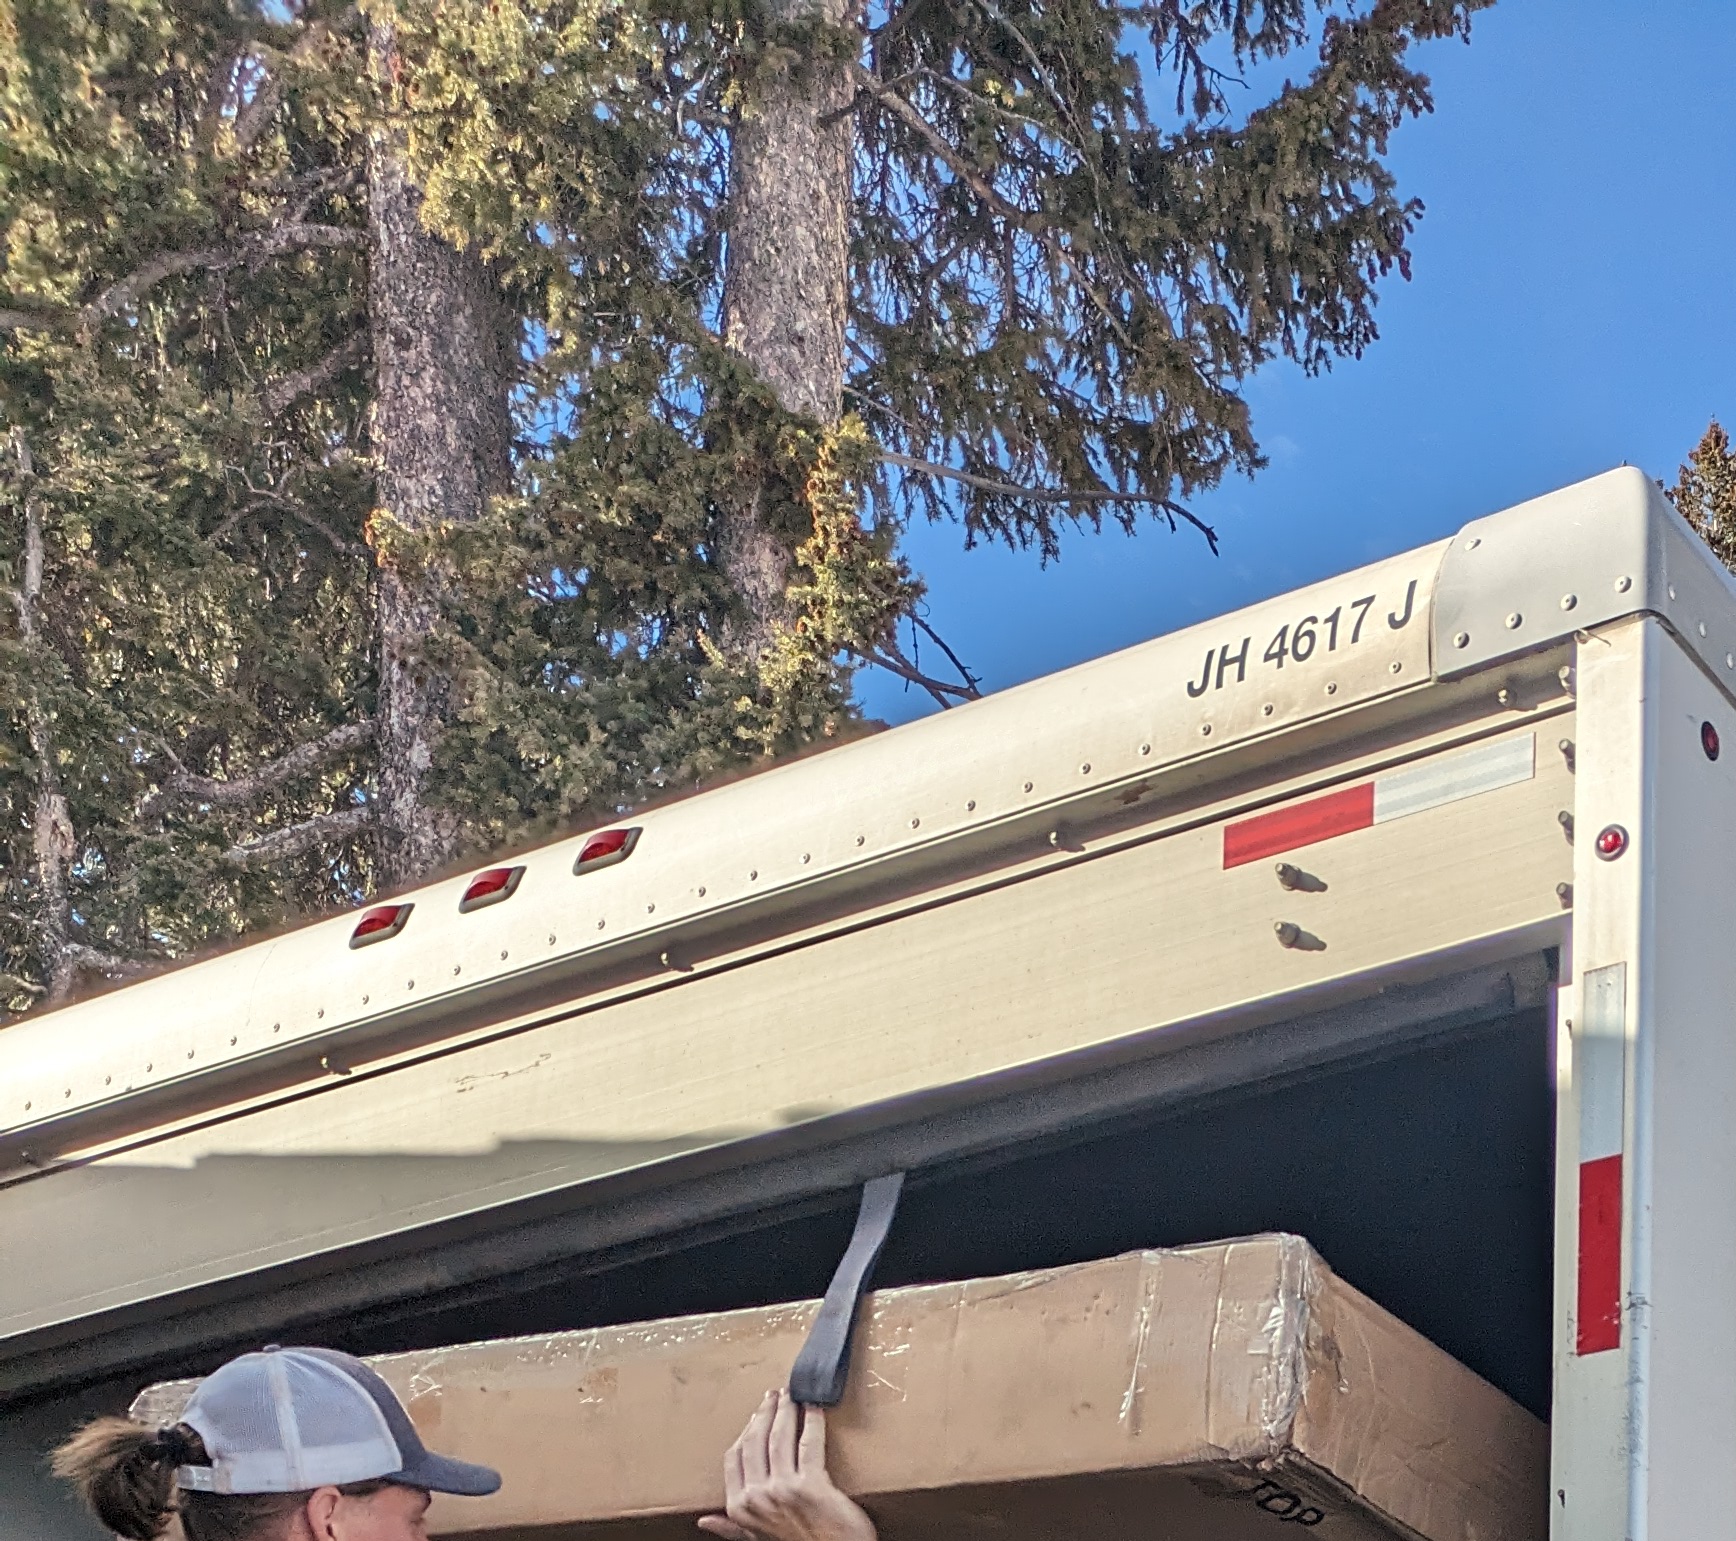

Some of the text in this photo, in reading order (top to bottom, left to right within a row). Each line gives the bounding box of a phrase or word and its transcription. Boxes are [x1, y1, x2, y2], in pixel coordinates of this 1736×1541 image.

[1186, 578, 1418, 700] JH 4617 J
